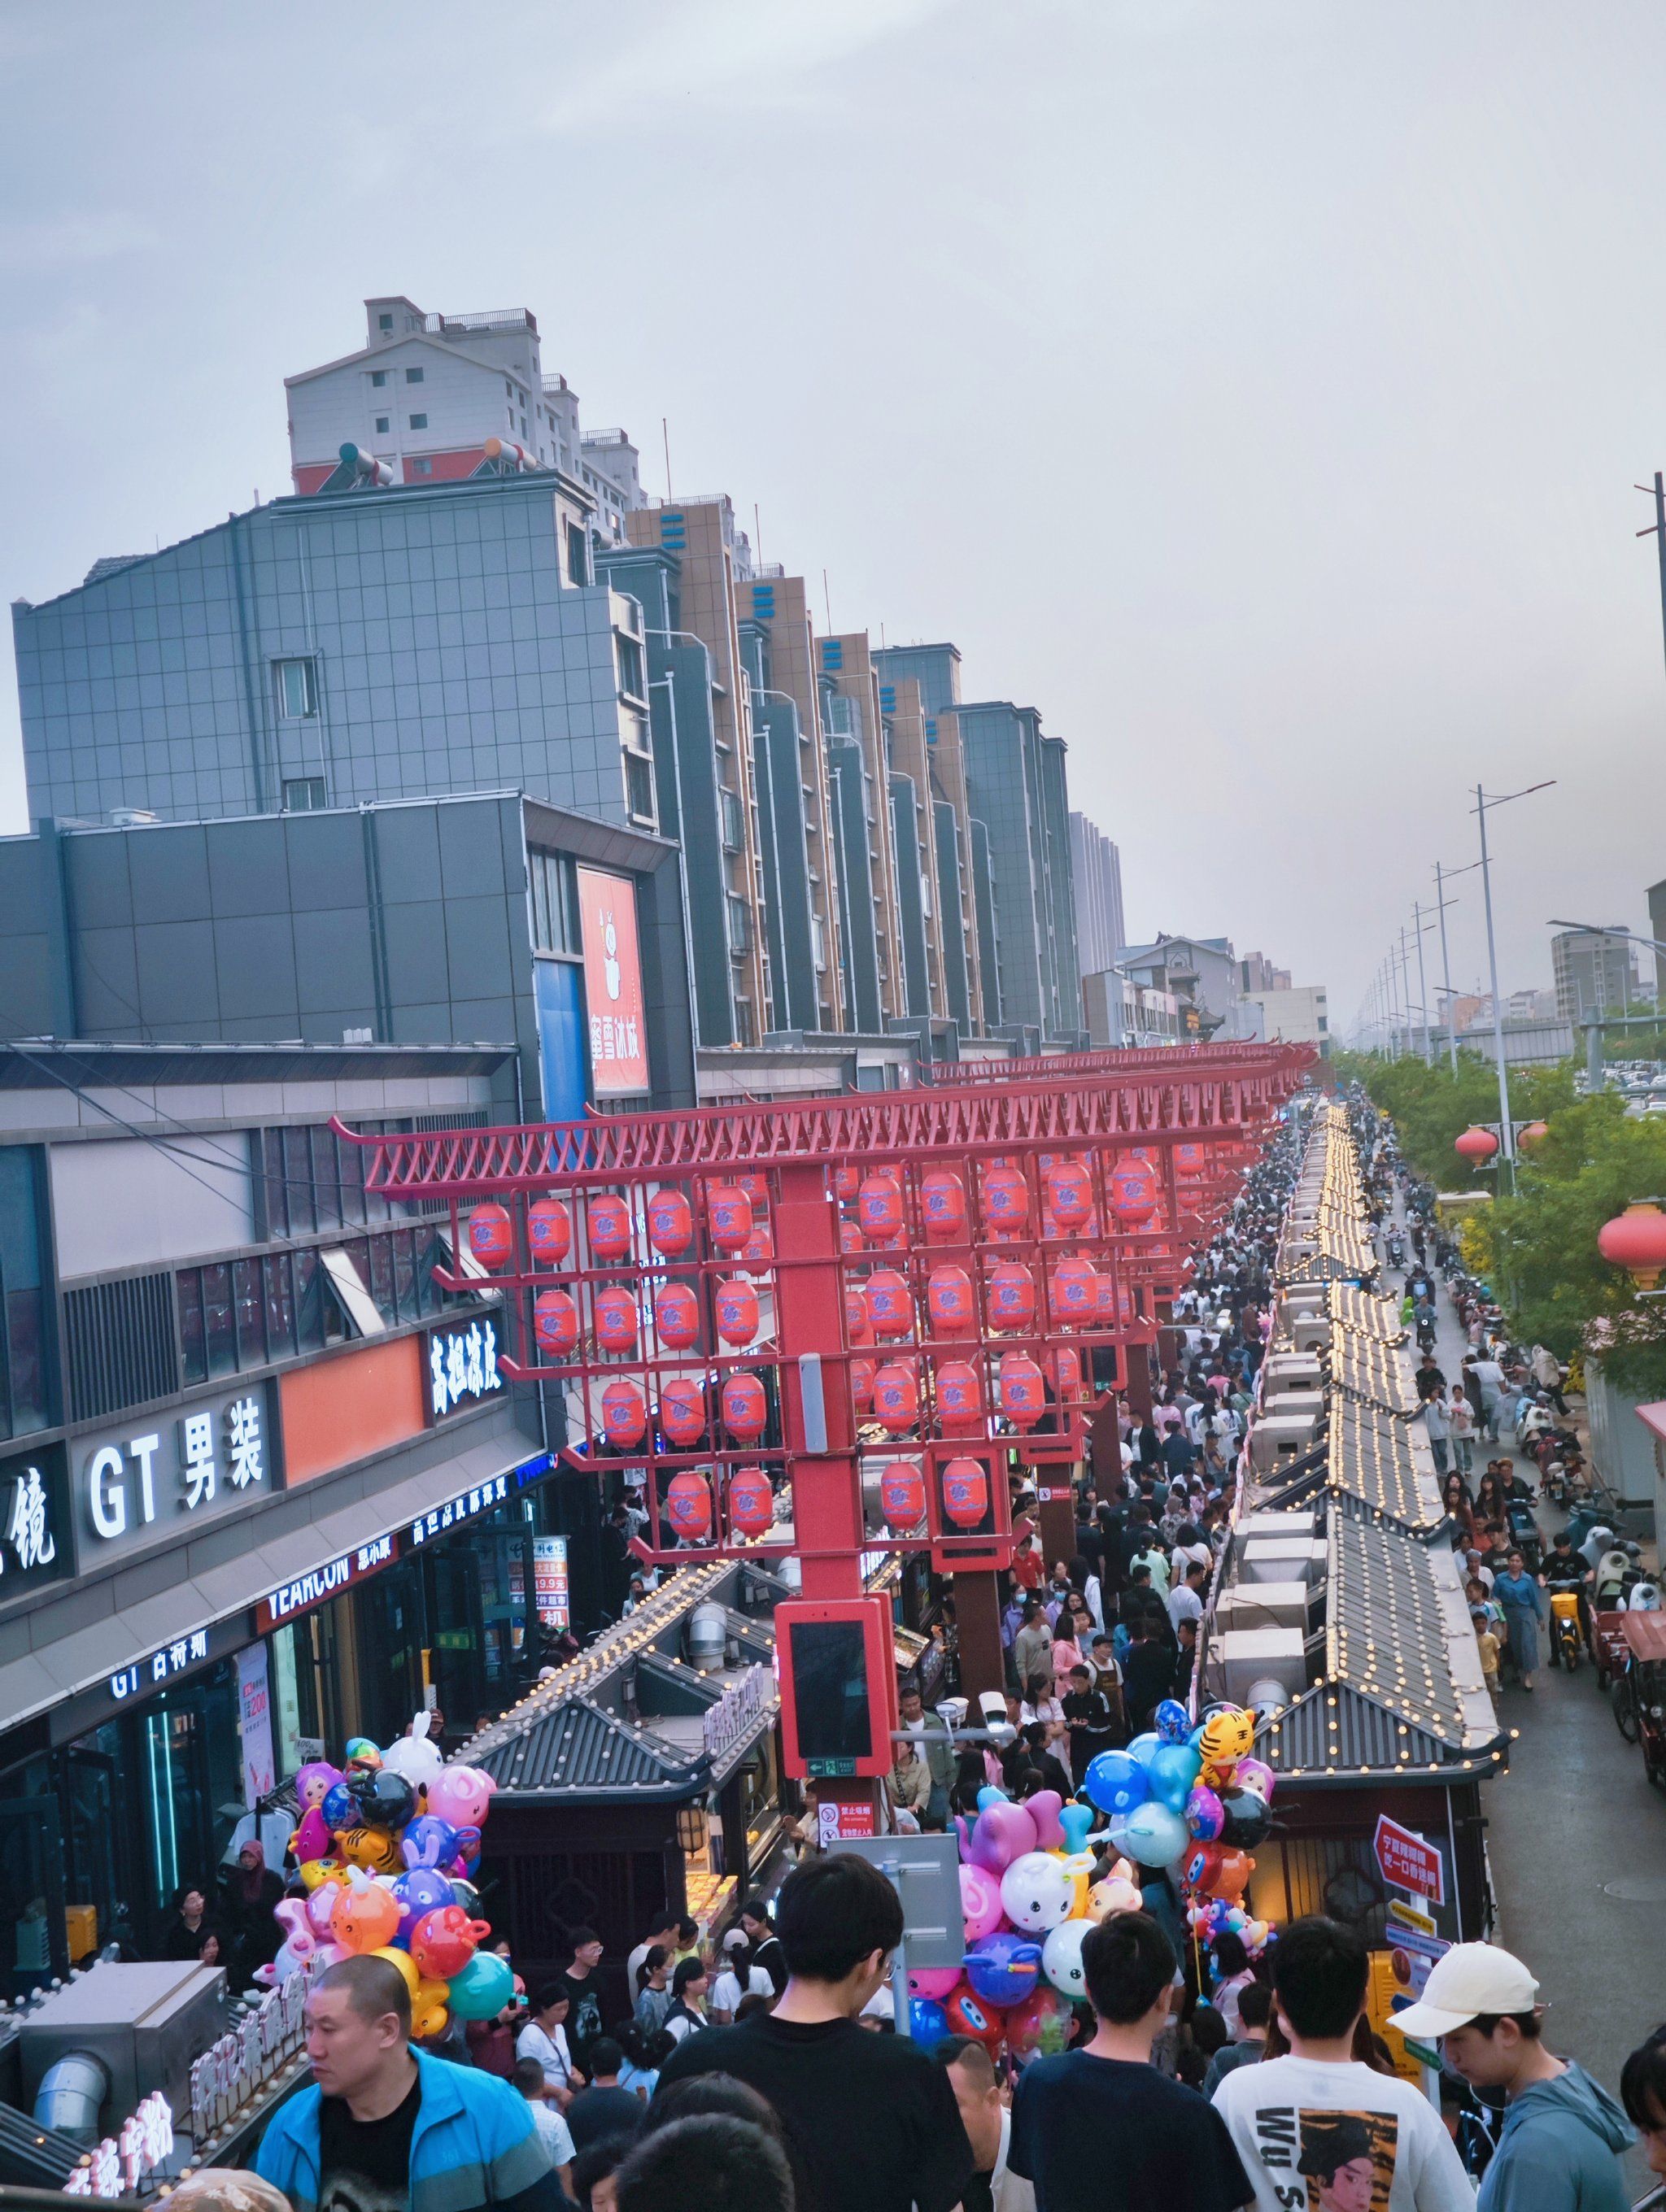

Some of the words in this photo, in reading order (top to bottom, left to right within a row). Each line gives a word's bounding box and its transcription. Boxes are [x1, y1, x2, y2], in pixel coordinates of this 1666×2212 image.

[591, 1014, 640, 1060] 蜜雪冰城
[90, 1434, 159, 1539] GT
[185, 1397, 264, 1509] 男装
[0, 1466, 56, 1576] 镜
[841, 1806, 871, 1815] 禁止吸烟
[1255, 2106, 1297, 2167] Wu
